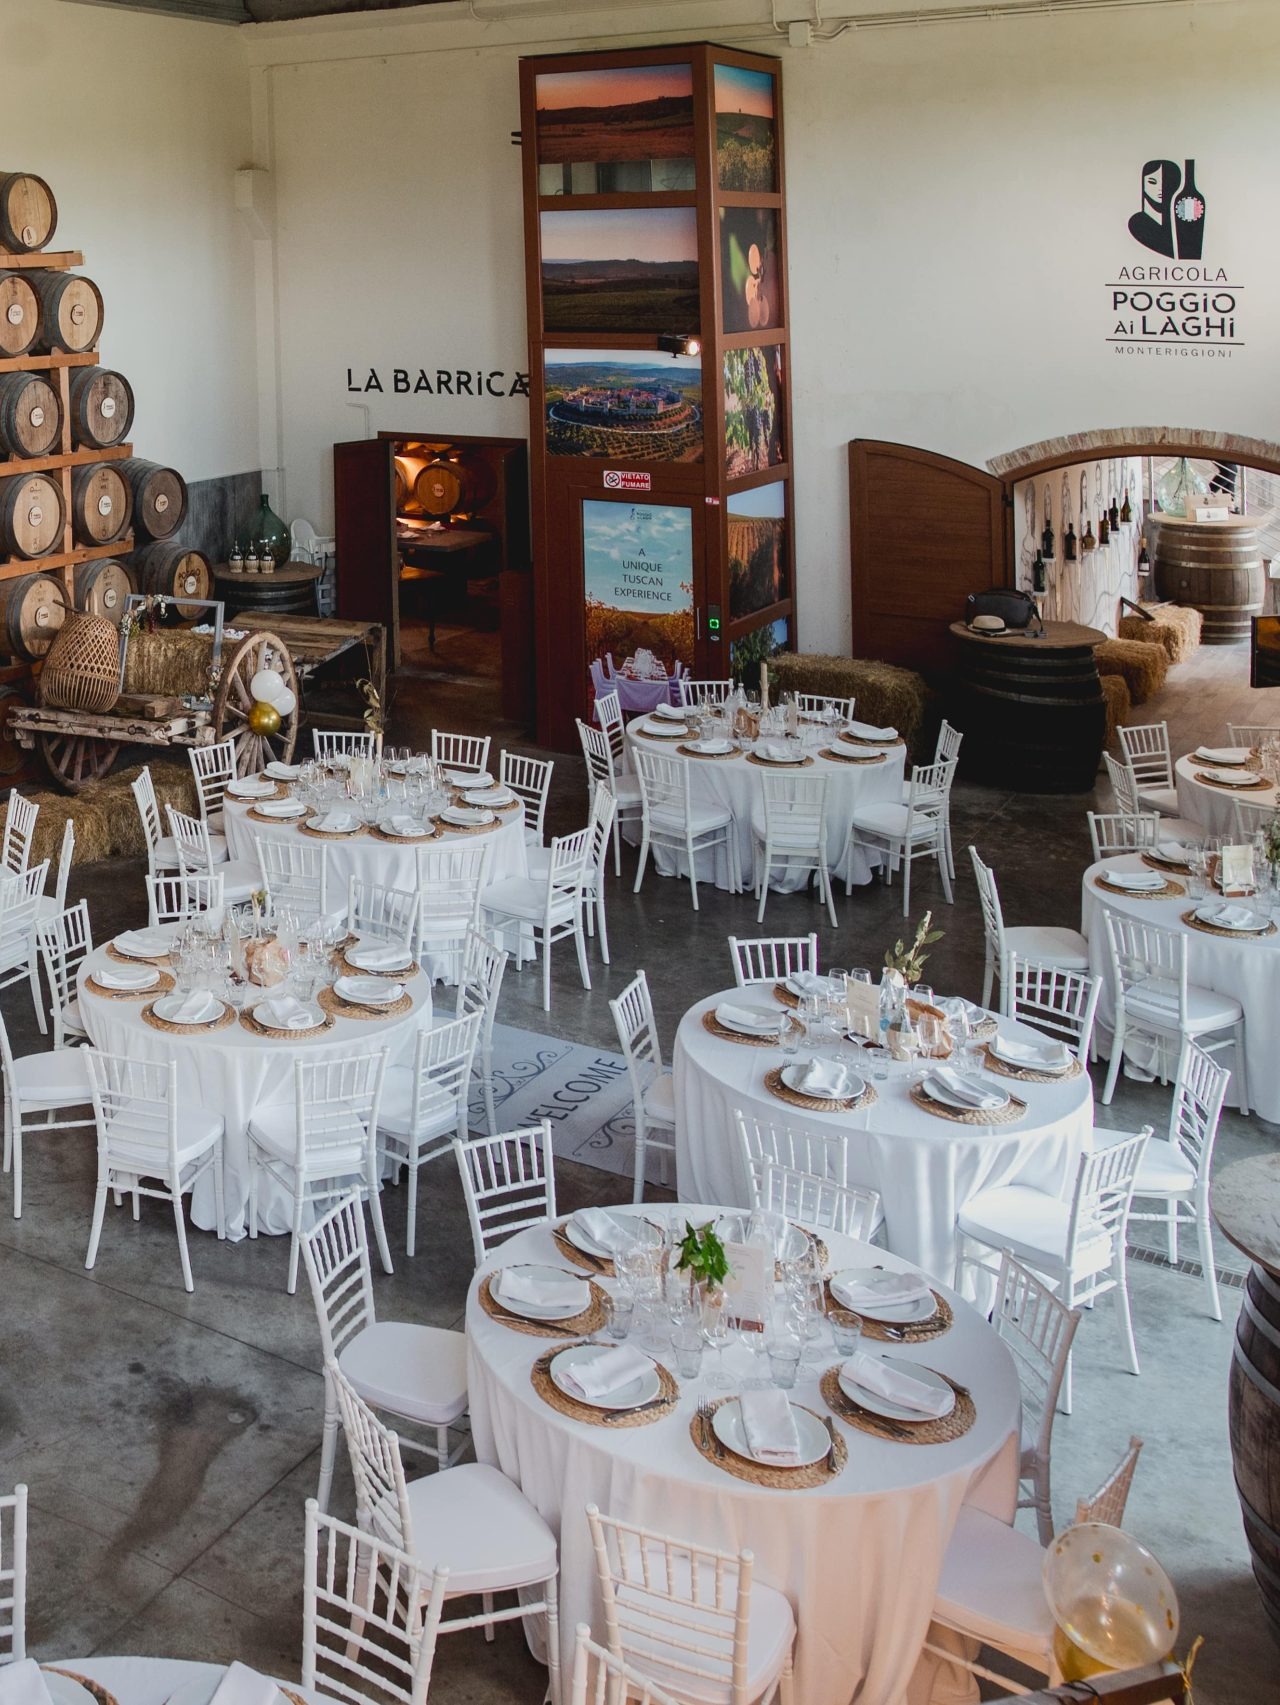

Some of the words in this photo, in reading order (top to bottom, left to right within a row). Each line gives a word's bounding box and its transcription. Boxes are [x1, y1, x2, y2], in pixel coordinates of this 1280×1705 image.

[1118, 266, 1228, 282] AGRICOLA
[1114, 346, 1232, 358] MONTERIGGIONI
[347, 368, 384, 393] LA
[621, 472, 649, 481] VIETATO
[621, 480, 650, 489] FUMARE
[638, 547, 646, 557] A
[622, 560, 663, 573] UNIQUE
[622, 574, 664, 587] TUSCAN
[614, 587, 673, 602] EXPERIENCE
